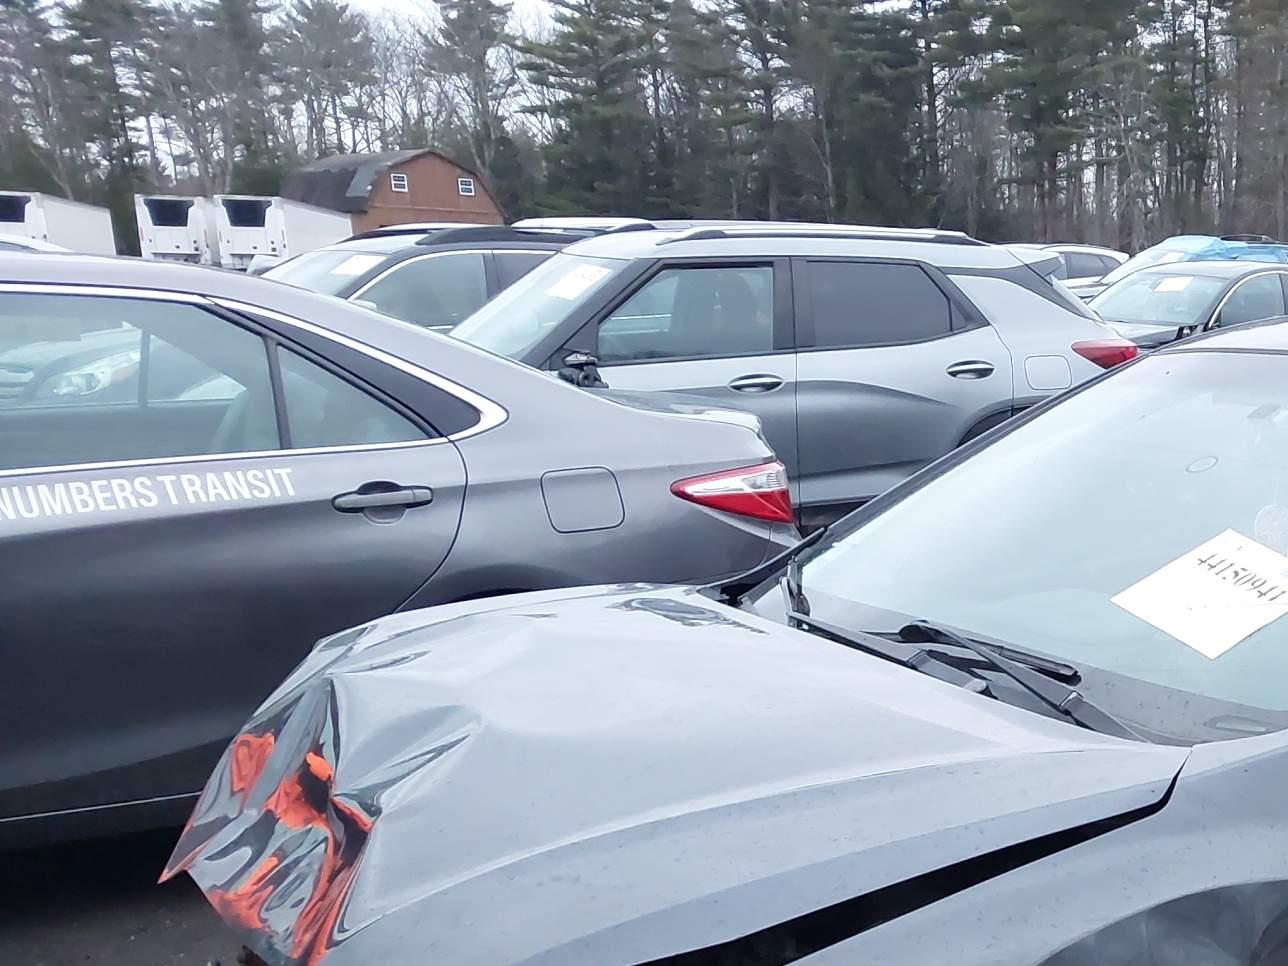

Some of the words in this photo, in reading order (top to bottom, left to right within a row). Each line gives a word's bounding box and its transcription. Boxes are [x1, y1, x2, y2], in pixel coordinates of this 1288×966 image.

[0, 477, 157, 520] NUMBERS
[157, 468, 296, 504] TRANSIT
[1197, 552, 1287, 601] 44150941
